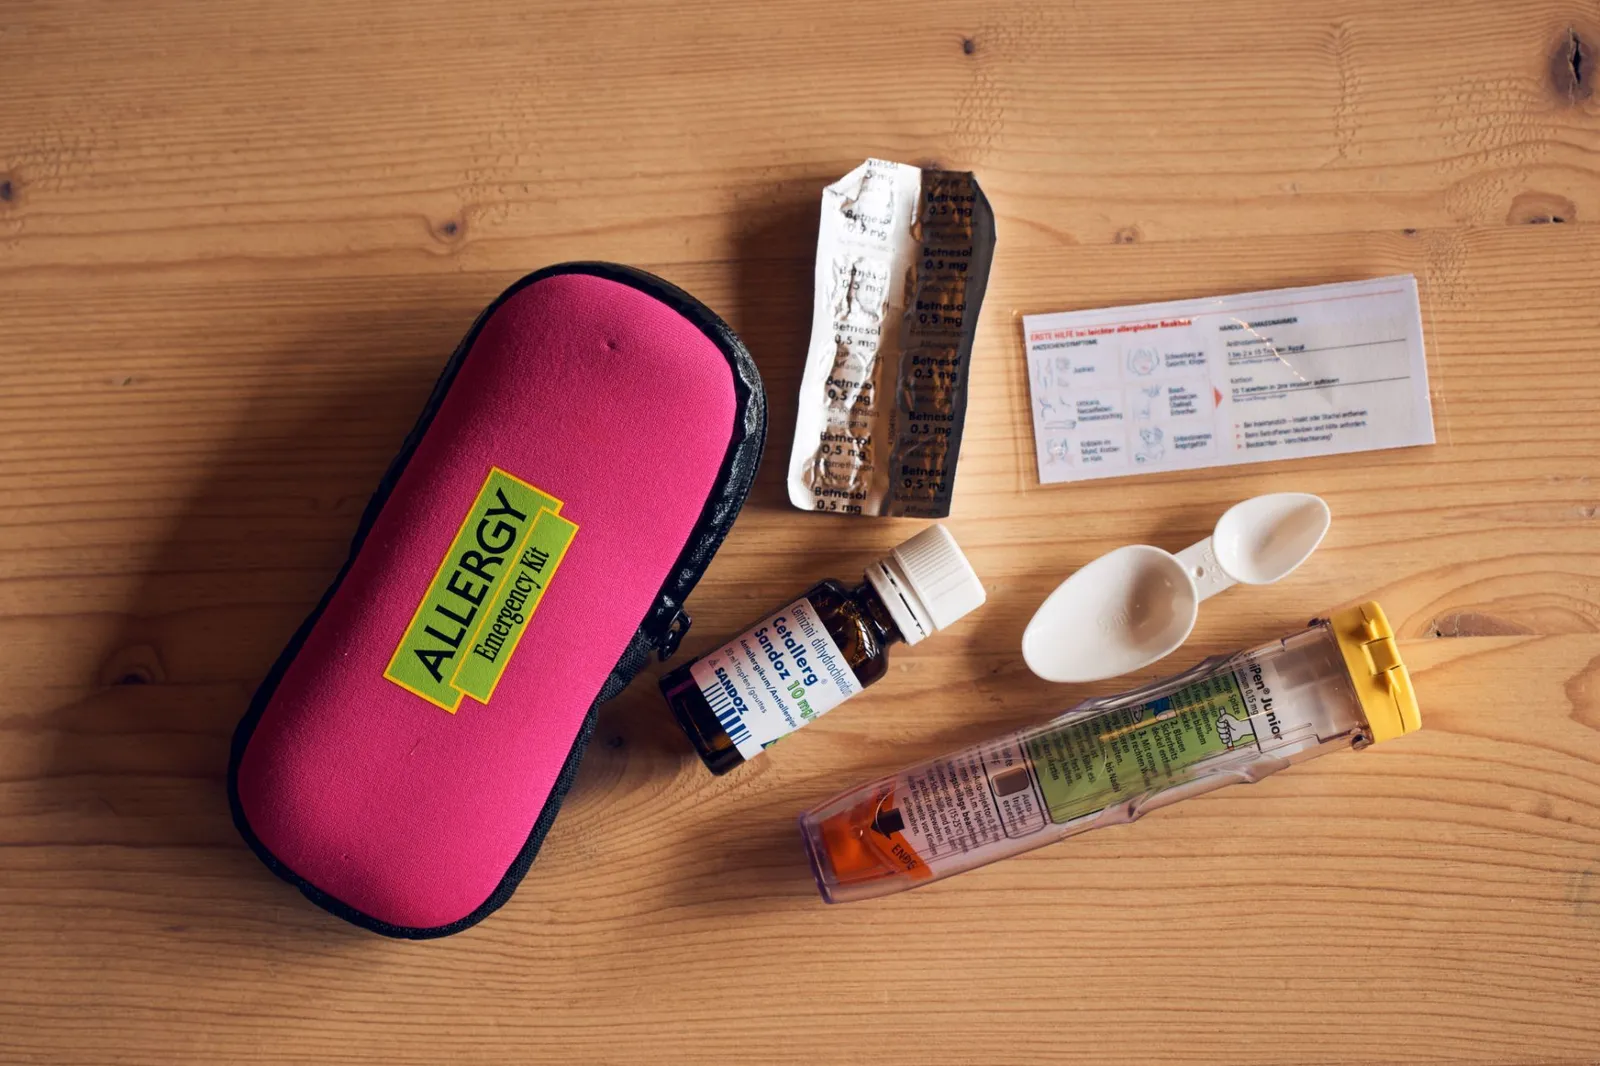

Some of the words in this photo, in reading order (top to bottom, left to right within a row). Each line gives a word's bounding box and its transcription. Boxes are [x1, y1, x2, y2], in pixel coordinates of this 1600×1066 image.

[924, 246, 973, 258] Betnesol
[925, 259, 944, 271] 0,5
[949, 260, 968, 272] mg
[916, 300, 966, 312] Betnesol
[919, 313, 940, 324] 0,5
[943, 314, 963, 326] mg
[833, 321, 881, 336] Betnesol
[1030, 332, 1051, 341] ERSTE
[1054, 330, 1073, 339] HILFE
[1087, 325, 1114, 335] leichter
[1116, 320, 1158, 334] allergischer
[858, 338, 877, 351] mg
[912, 356, 961, 366] Betnesol
[914, 368, 934, 379] 0,5
[938, 370, 957, 382] mg
[828, 389, 848, 401] 0,5
[853, 392, 871, 406] mg
[910, 424, 930, 434] 0,5
[934, 426, 952, 438] mg
[822, 444, 842, 456] 0,5
[848, 447, 866, 460] mg
[904, 478, 925, 489] 0,5
[928, 480, 946, 492] mg
[814, 486, 867, 501] Betnesol
[816, 500, 837, 511] 0,5
[842, 501, 862, 514] mg
[413, 487, 527, 684] ALLERGY
[473, 571, 541, 663] Emergency
[520, 546, 550, 574] Kit
[792, 604, 817, 638] Cetirizini
[754, 627, 791, 680] Sandoz
[787, 680, 806, 700] 10
[714, 667, 750, 716] SANDOZ
[733, 659, 768, 714] Tropfen/gouttes
[1245, 688, 1255, 704] 0,15
[1227, 693, 1240, 716] Spitze
[1249, 703, 1258, 716] mg
[1170, 720, 1177, 728] 2.
[1198, 705, 1213, 733] nehmen,
[1262, 696, 1283, 741] Junior
[1139, 729, 1146, 738] 3.
[1152, 725, 1165, 749] deckel
[1193, 719, 1206, 744] blauem
[1142, 738, 1151, 751] Mit
[1160, 723, 1177, 760] Sicherheits
[1173, 728, 1185, 752] Blauen
[1111, 741, 1122, 765] halten.
[1132, 741, 1145, 766] rechten
[1071, 758, 1080, 771] fest
[1105, 761, 1113, 772] bis
[1061, 762, 1074, 786] halten.
[1075, 772, 1081, 780] in
[970, 796, 979, 810] i.m.
[1022, 793, 1033, 815] Auto-
[903, 796, 920, 835] aufbewahren.
[926, 803, 944, 843] aufbewahren.
[940, 812, 948, 825] und
[891, 843, 917, 870] ENDE
